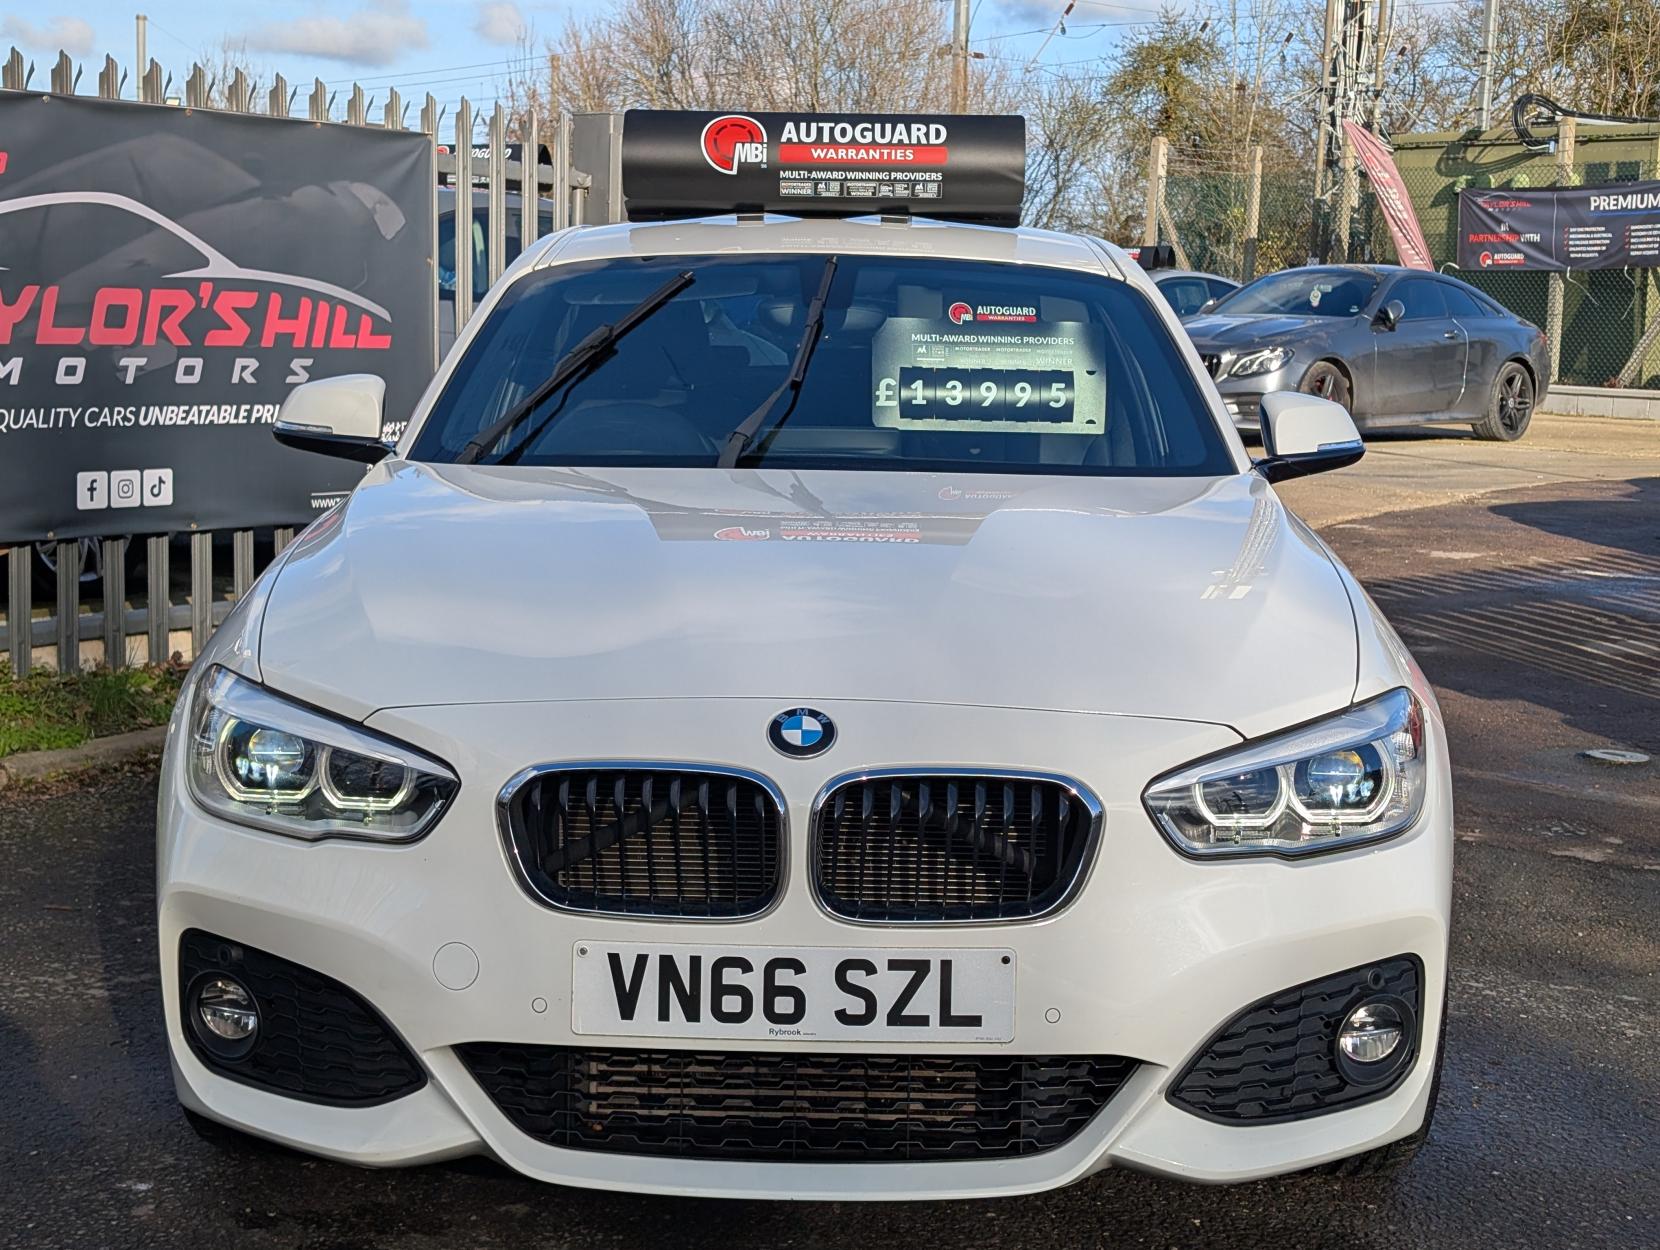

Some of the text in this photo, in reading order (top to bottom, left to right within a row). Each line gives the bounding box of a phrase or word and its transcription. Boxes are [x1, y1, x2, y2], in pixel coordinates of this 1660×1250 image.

[780, 121, 947, 145] AUTOGUARD
[732, 142, 768, 164] MBi
[811, 147, 914, 161] WARRANTIES
[779, 170, 943, 181] MULTI-AWARD WINNING PROVIDERS
[1590, 193, 1660, 211] PREMIUM
[1520, 233, 1541, 242] WITH
[0, 282, 258, 346] YLOR'S
[976, 305, 1037, 316] AUTOGUARD
[911, 333, 1075, 345] MULTI-AWARD WINNING PROVIDERS
[0, 357, 314, 385] MOTORS
[0, 404, 281, 433] QUALITY CARS UNBEATABLE PRI
[776, 708, 831, 724] BMW
[607, 952, 983, 1028] VN66 SZL
[768, 1027, 801, 1037] Rybrook
